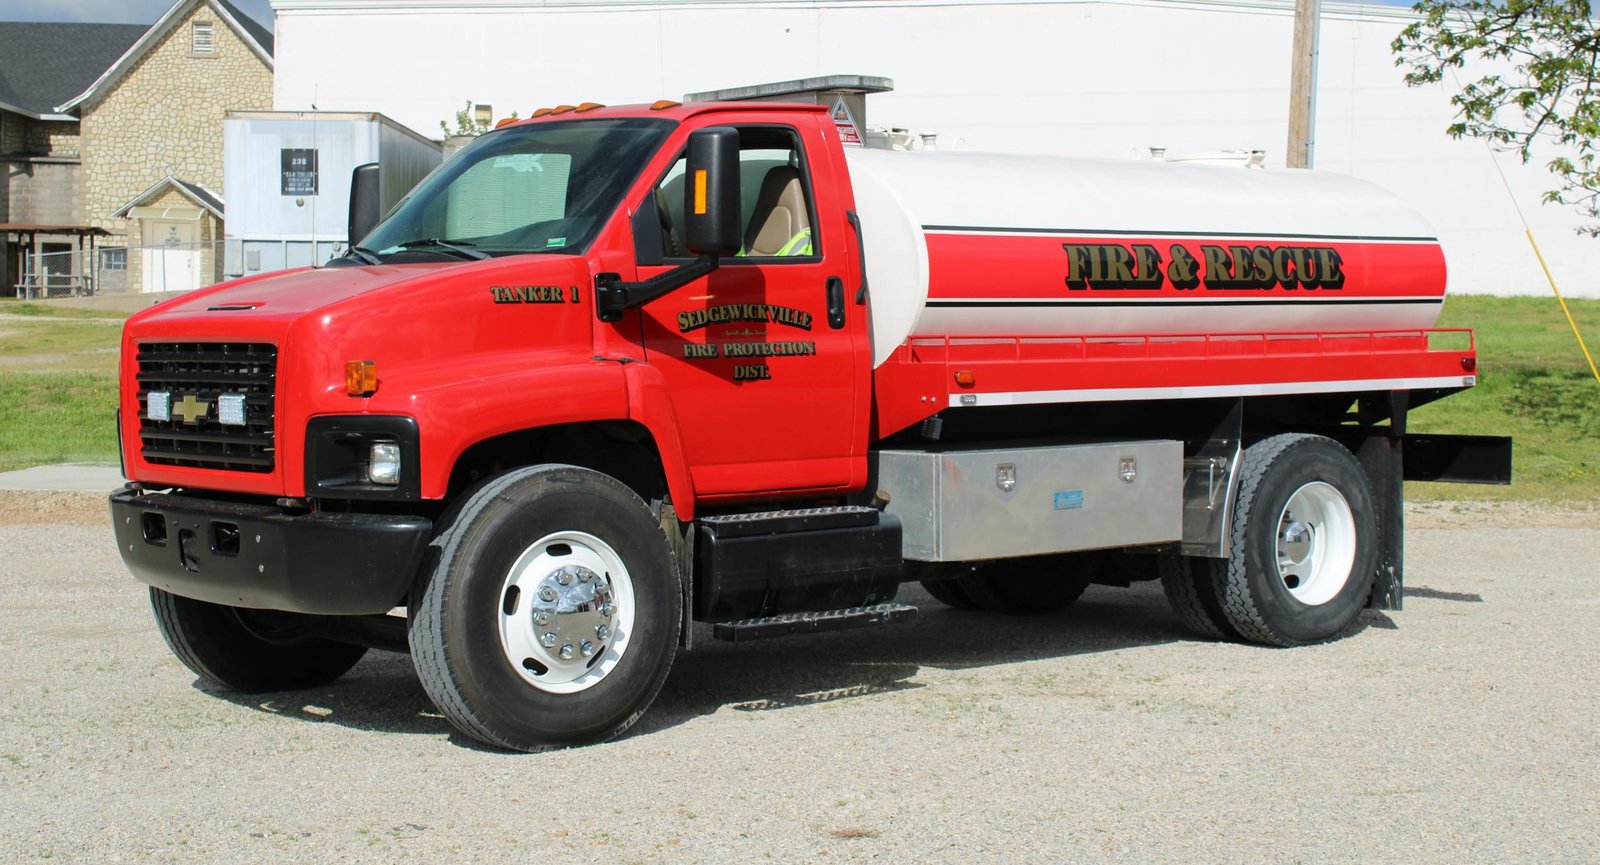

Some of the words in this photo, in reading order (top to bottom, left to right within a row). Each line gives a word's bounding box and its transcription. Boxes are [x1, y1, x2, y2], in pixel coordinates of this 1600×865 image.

[1063, 243, 1163, 290] FIRE
[1168, 244, 1200, 290] &
[1200, 245, 1345, 290] RESCUE
[490, 286, 565, 304] TANKER
[570, 286, 581, 304] 1
[677, 304, 812, 332] SEDGEWICKVILLE
[683, 343, 719, 359] FIRE
[723, 341, 816, 357] PROTECTION
[733, 364, 771, 379] DIST.
